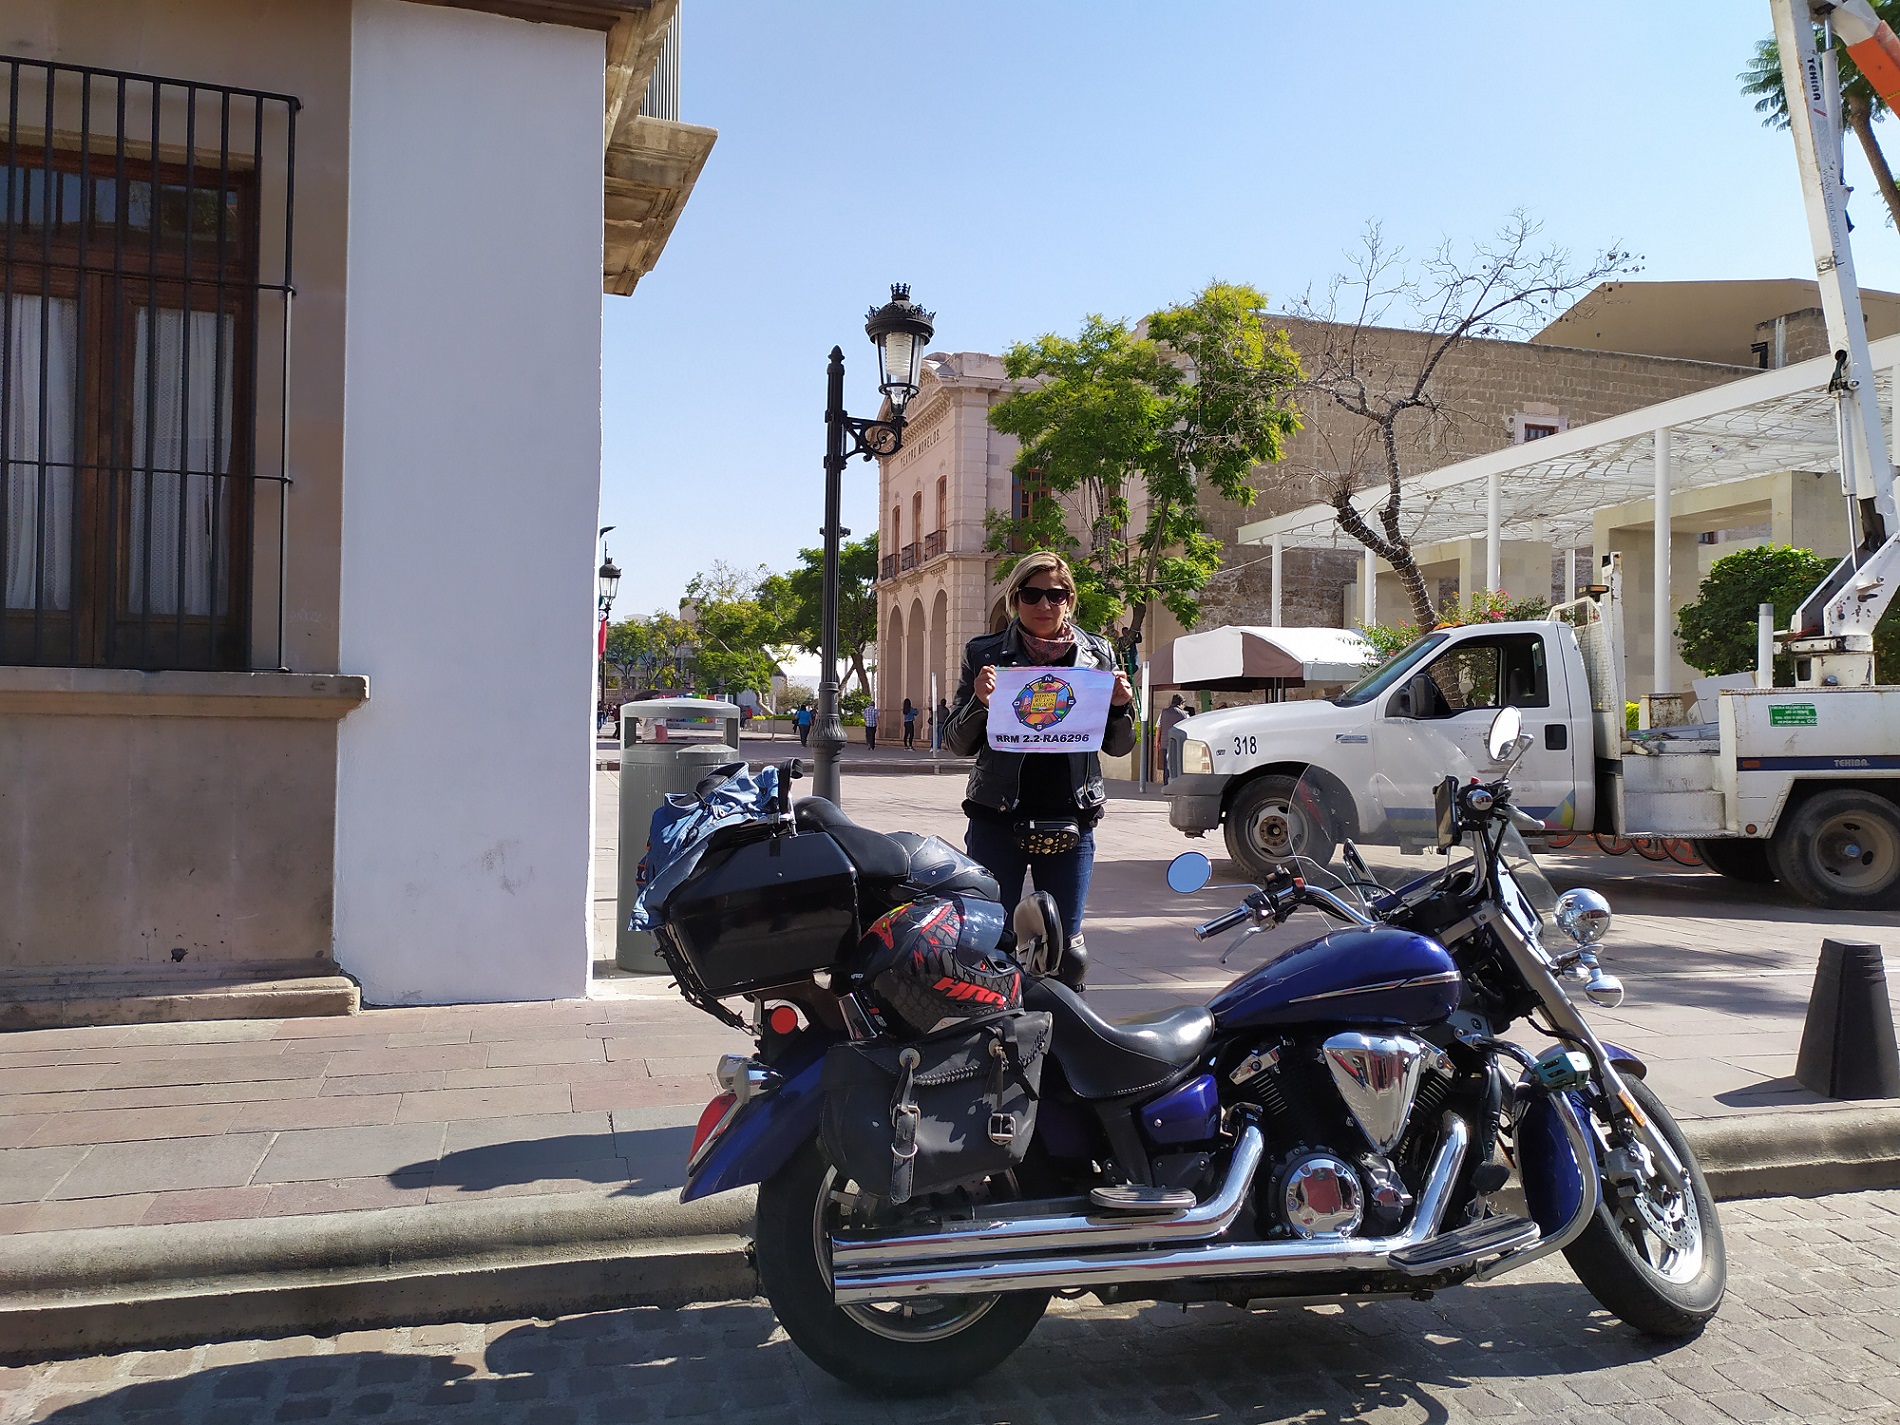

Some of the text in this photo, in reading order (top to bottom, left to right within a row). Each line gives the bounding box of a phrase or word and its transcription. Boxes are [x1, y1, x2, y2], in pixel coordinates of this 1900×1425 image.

[996, 734, 1090, 743] RRM 2.2-RA6296
[1233, 735, 1257, 756] 318
